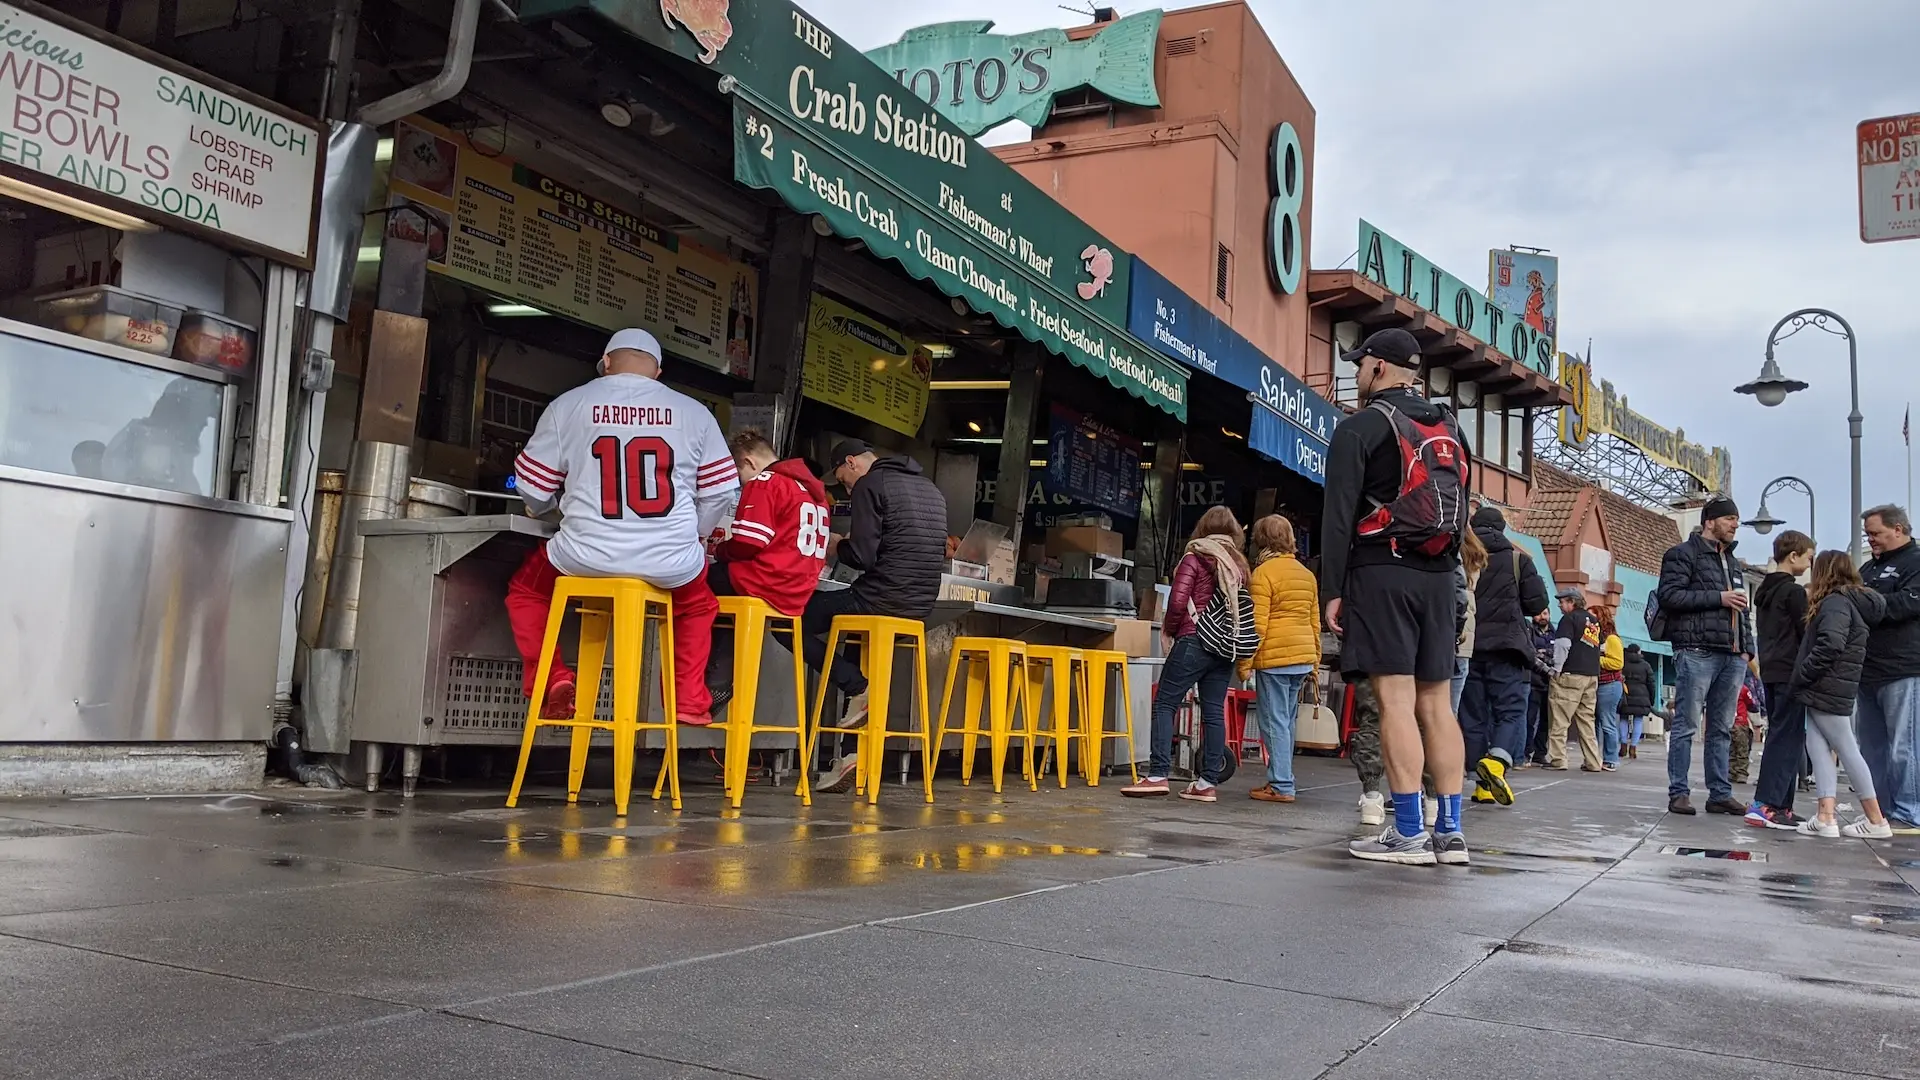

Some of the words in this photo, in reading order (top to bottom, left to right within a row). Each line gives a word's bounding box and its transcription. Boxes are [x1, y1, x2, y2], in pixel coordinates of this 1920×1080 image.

[792, 10, 832, 59] THE
[0, 51, 120, 126] NDER
[156, 76, 306, 156] SANDWICH
[789, 65, 866, 135] Crab
[874, 93, 967, 168] Station
[13, 94, 170, 181] BOWLS
[190, 125, 274, 172] LOBSTER
[746, 115, 774, 161] #2
[1862, 138, 1896, 163] NO
[57, 154, 127, 196] AND
[140, 179, 221, 228] SODA
[191, 173, 263, 210] SHRIMP
[204, 155, 255, 186] CRAB
[540, 178, 588, 209] Crab
[593, 201, 659, 241] Station
[938, 181, 1017, 255] Fisherman's
[1018, 235, 1053, 278] Wharf
[1001, 192, 1013, 213] at
[1269, 121, 1304, 295] 8
[1892, 192, 1920, 211] TI
[791, 149, 853, 213] Fresh
[855, 190, 898, 241] Crab
[916, 228, 958, 276] Clam
[959, 255, 1017, 312] Chowder
[1030, 297, 1060, 337] Fried
[1364, 232, 1550, 377] ALIOTO'S
[1498, 266, 1511, 287] 9
[1156, 298, 1168, 320] No.
[1170, 308, 1176, 325] 3
[1154, 320, 1196, 361] Fisherman's
[1197, 348, 1217, 375] Wharf
[592, 404, 672, 426] GAROPPOLO
[1260, 365, 1312, 428] Sabella
[1318, 415, 1327, 438] &
[1572, 363, 1588, 444] 9
[591, 435, 675, 520] 10
[797, 501, 830, 560] 85
